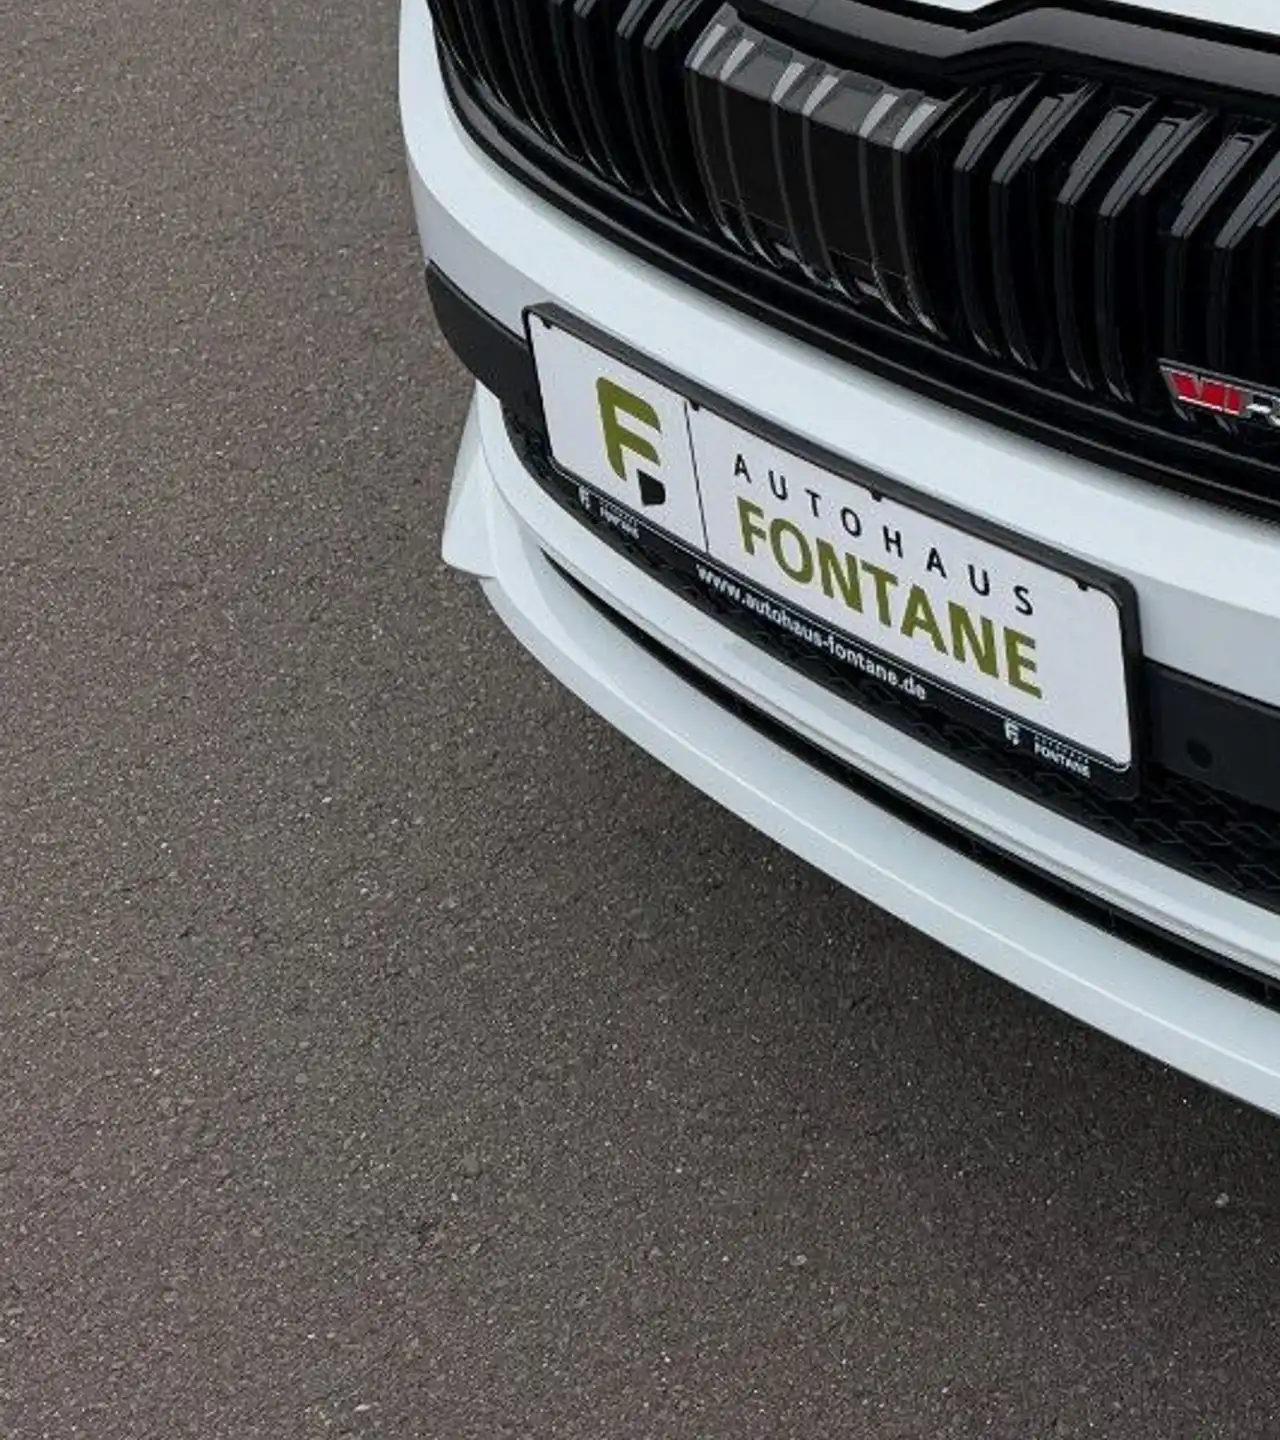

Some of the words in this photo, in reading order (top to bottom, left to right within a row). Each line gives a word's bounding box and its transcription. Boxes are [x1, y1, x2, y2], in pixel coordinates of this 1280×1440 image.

[734, 453, 1035, 616] AUTOHAUS
[736, 495, 1044, 700] FONTANE
[695, 563, 928, 701] www.autohaus-fontane.de
